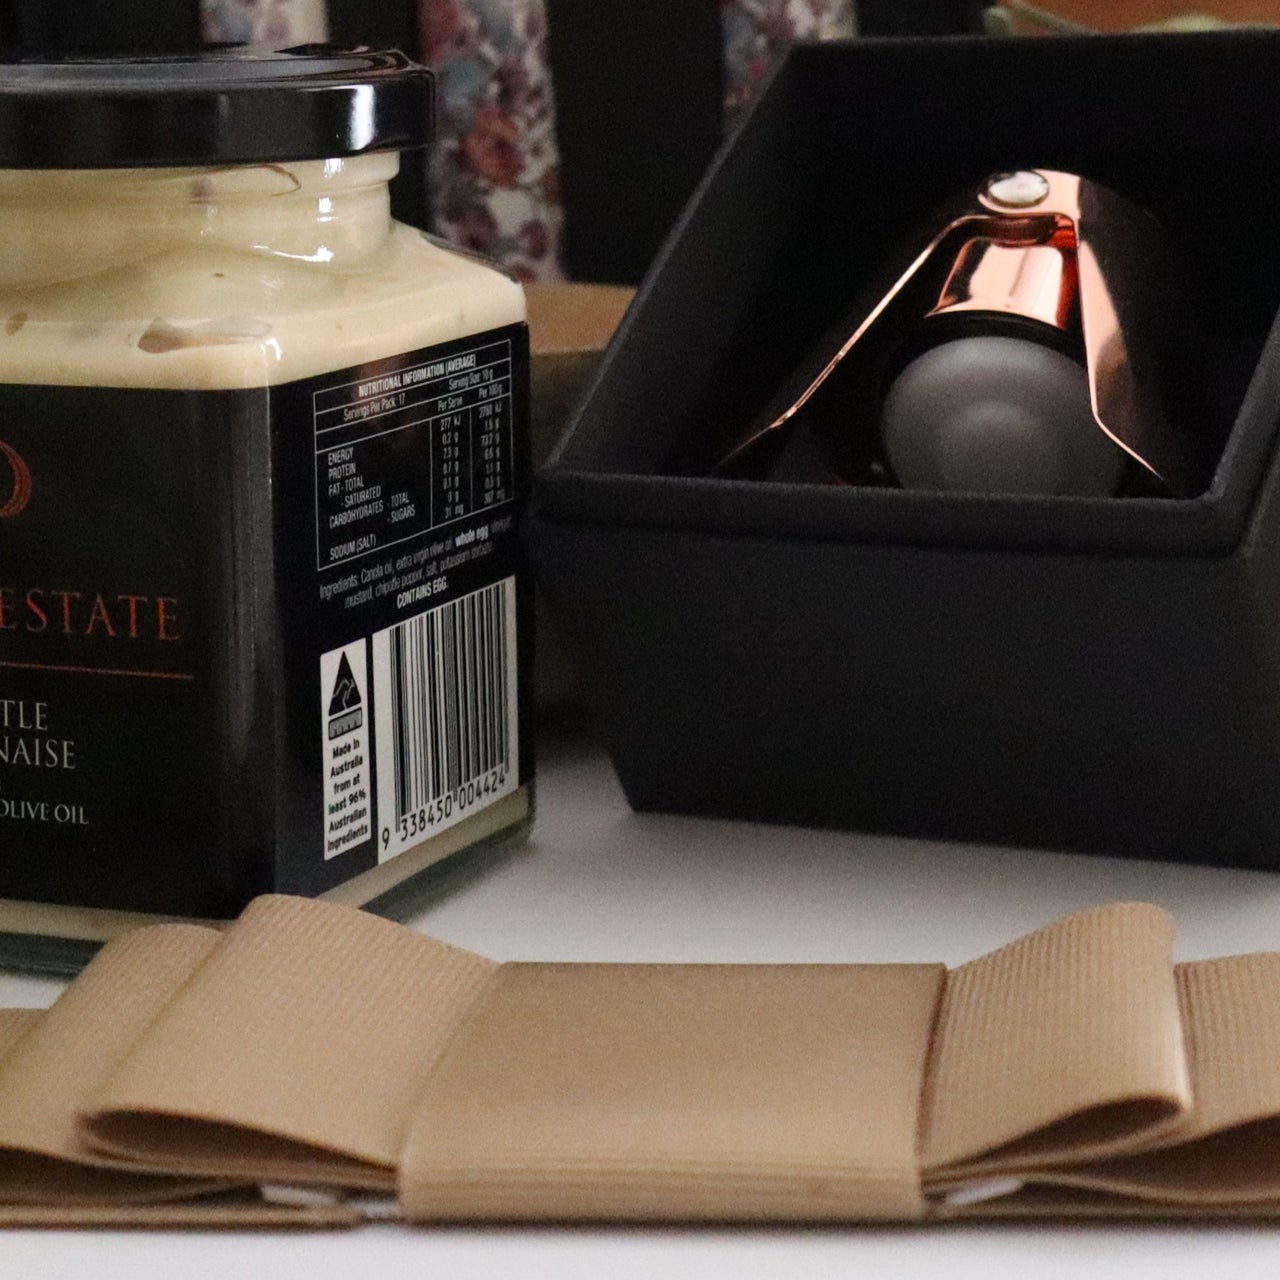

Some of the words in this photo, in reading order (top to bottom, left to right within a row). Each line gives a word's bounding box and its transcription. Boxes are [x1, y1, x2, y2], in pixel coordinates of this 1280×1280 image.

[358, 375, 402, 398] NUTRITIONAL
[403, 361, 445, 385] INFORMATION
[445, 353, 477, 376] (AVERAGE)
[343, 404, 370, 422] Servings
[398, 392, 406, 405] 17
[328, 447, 354, 466] ENERGY
[328, 462, 356, 481] PROTEIN
[328, 482, 340, 497] FAT
[345, 474, 365, 492] TOTAL
[344, 485, 382, 508] SATURATED
[329, 500, 384, 529] CARBOHYDRATES
[391, 491, 410, 508] TOTAL
[391, 504, 416, 523] SUGARS
[330, 540, 356, 561] SODIUM
[356, 533, 377, 553] (SALT)
[455, 528, 475, 547] whole
[396, 581, 432, 609] CONTAINS
[332, 742, 351, 759] Made
[330, 755, 363, 779] Australia
[334, 779, 351, 795] from
[353, 773, 360, 786] at
[328, 797, 347, 816] least
[348, 788, 366, 806] 96%
[382, 827, 390, 851] 9
[401, 794, 452, 842] 338450
[459, 765, 506, 811] 004424
[53, 805, 89, 826] OIL
[329, 806, 367, 833] Australian
